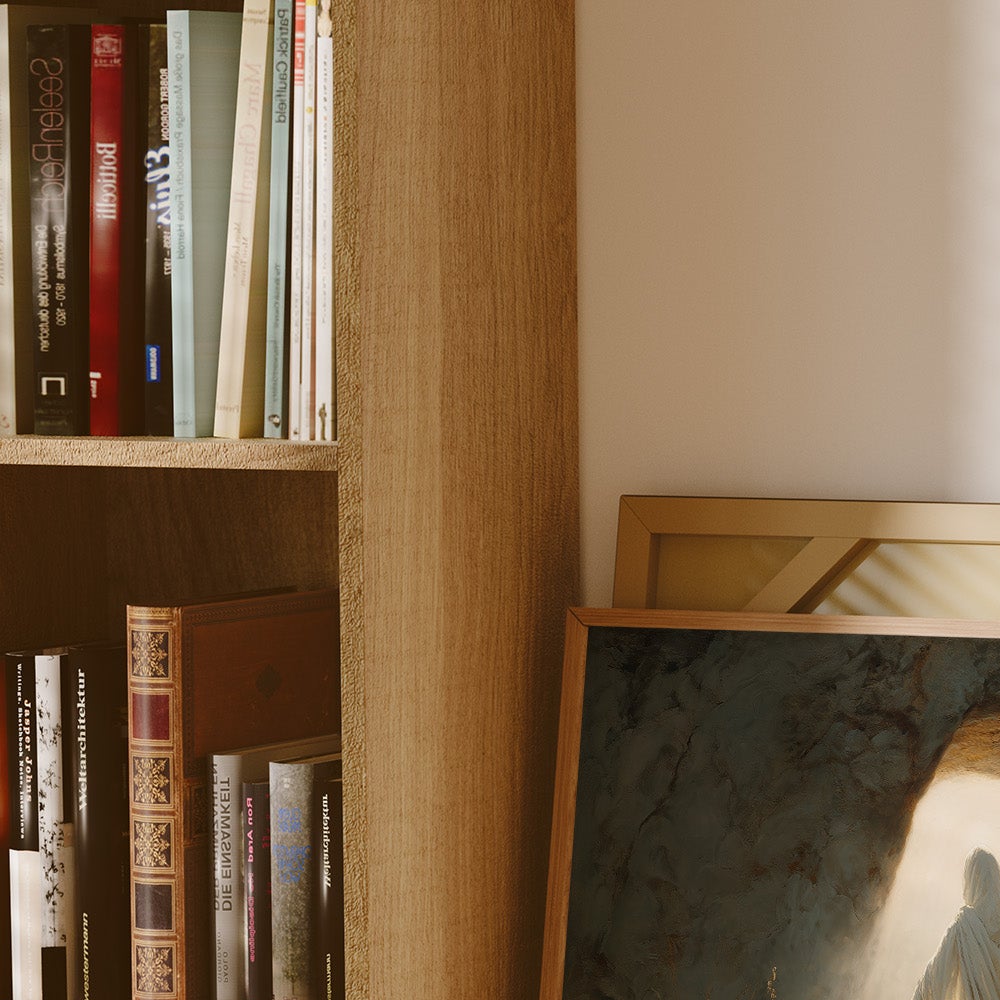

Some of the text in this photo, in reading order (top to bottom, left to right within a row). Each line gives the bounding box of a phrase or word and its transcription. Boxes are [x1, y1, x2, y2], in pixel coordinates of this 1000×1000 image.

[24, 700, 33, 803] Jasper Johns
[77, 669, 88, 810] Weltarchitektur
